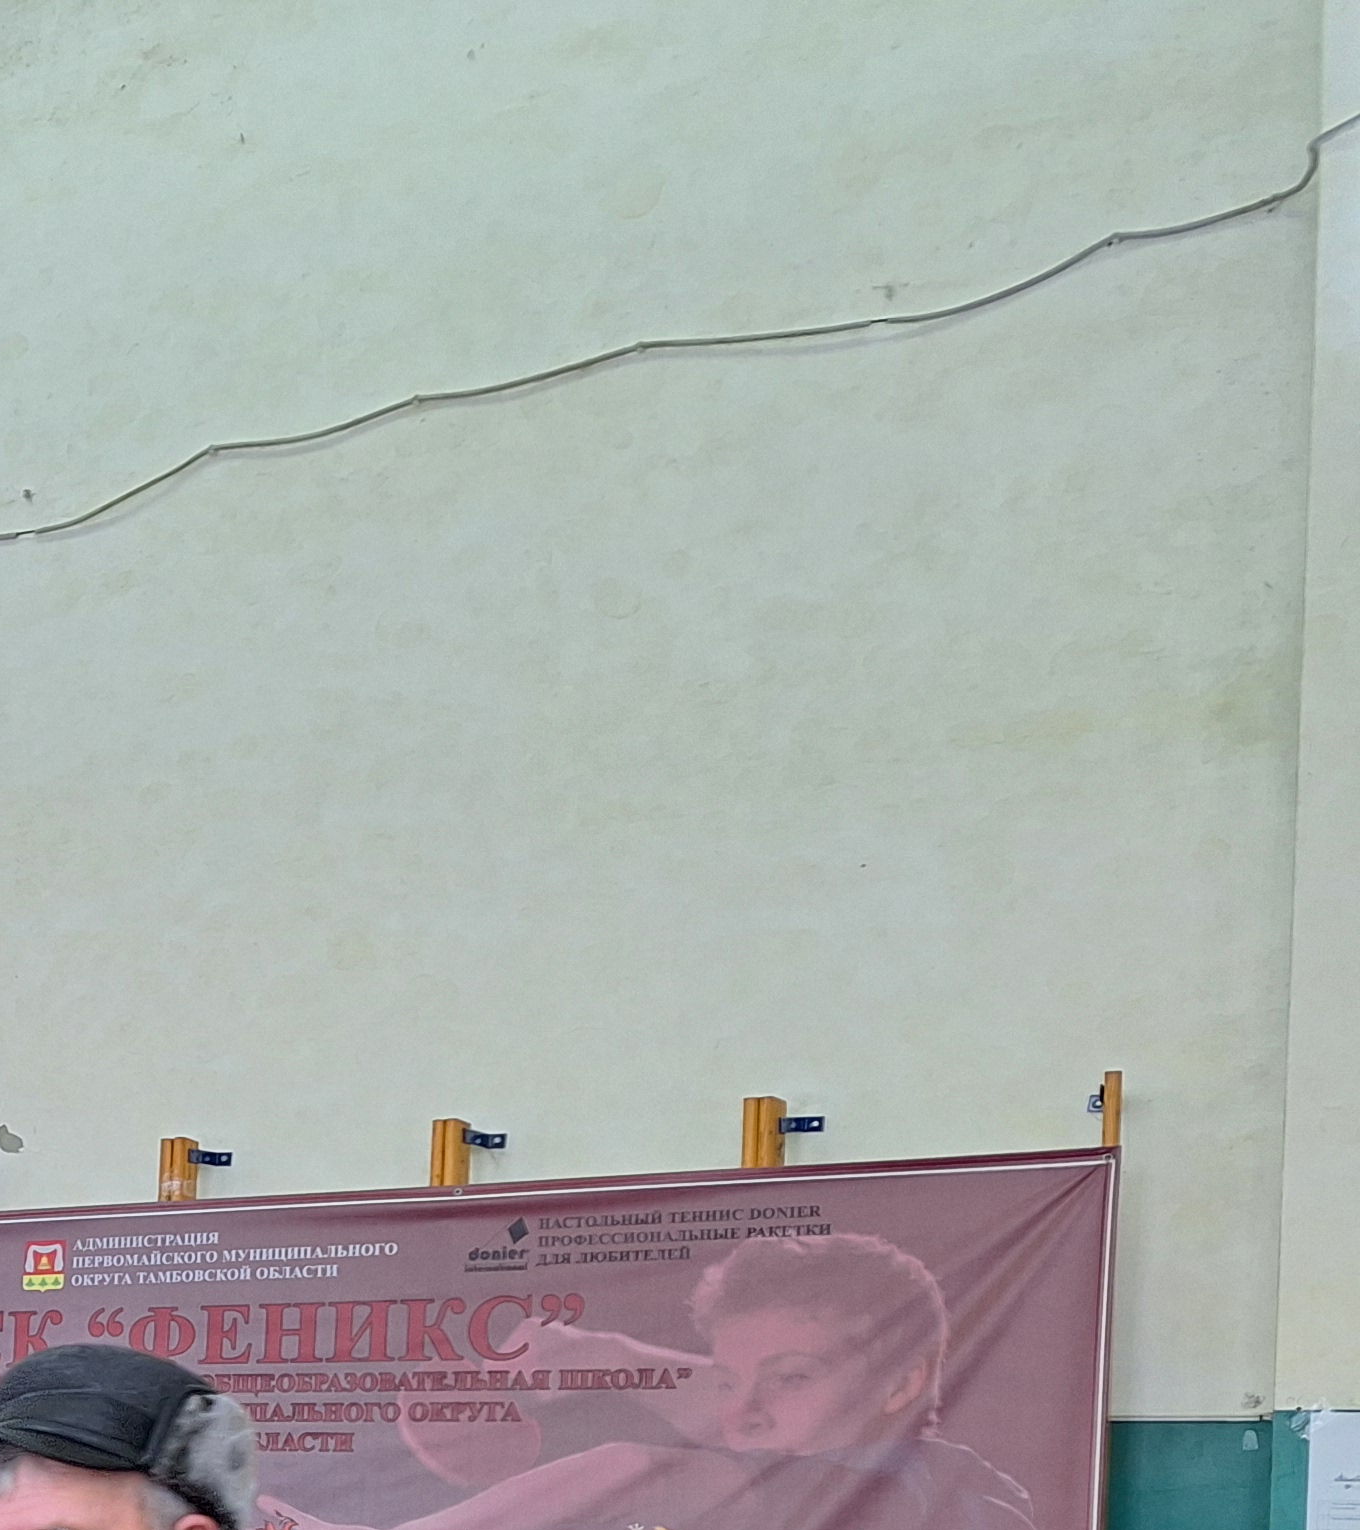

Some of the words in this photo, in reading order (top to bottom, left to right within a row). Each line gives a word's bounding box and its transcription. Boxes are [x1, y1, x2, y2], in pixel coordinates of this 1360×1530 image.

[670, 1208, 745, 1224] ТЕННИС
[749, 1204, 821, 1221] DONIER
[72, 1231, 220, 1252] АДМИНИСТРАЦИЯ
[746, 1223, 832, 1239] РАКЕТКИ
[71, 1250, 218, 1269] ПЕРВОМАЙСКОГО
[222, 1242, 399, 1264] МУНИЦИПАЛЬНОГО
[468, 1245, 528, 1261] donier
[70, 1271, 133, 1287] ОКРУГА
[136, 1265, 251, 1285] ТАМБОВСКОЙ
[255, 1264, 339, 1281] ОБЛАСТИ
[240, 1402, 401, 1423] ПАЛЬНОГО
[407, 1401, 522, 1423] ОКРУГА
